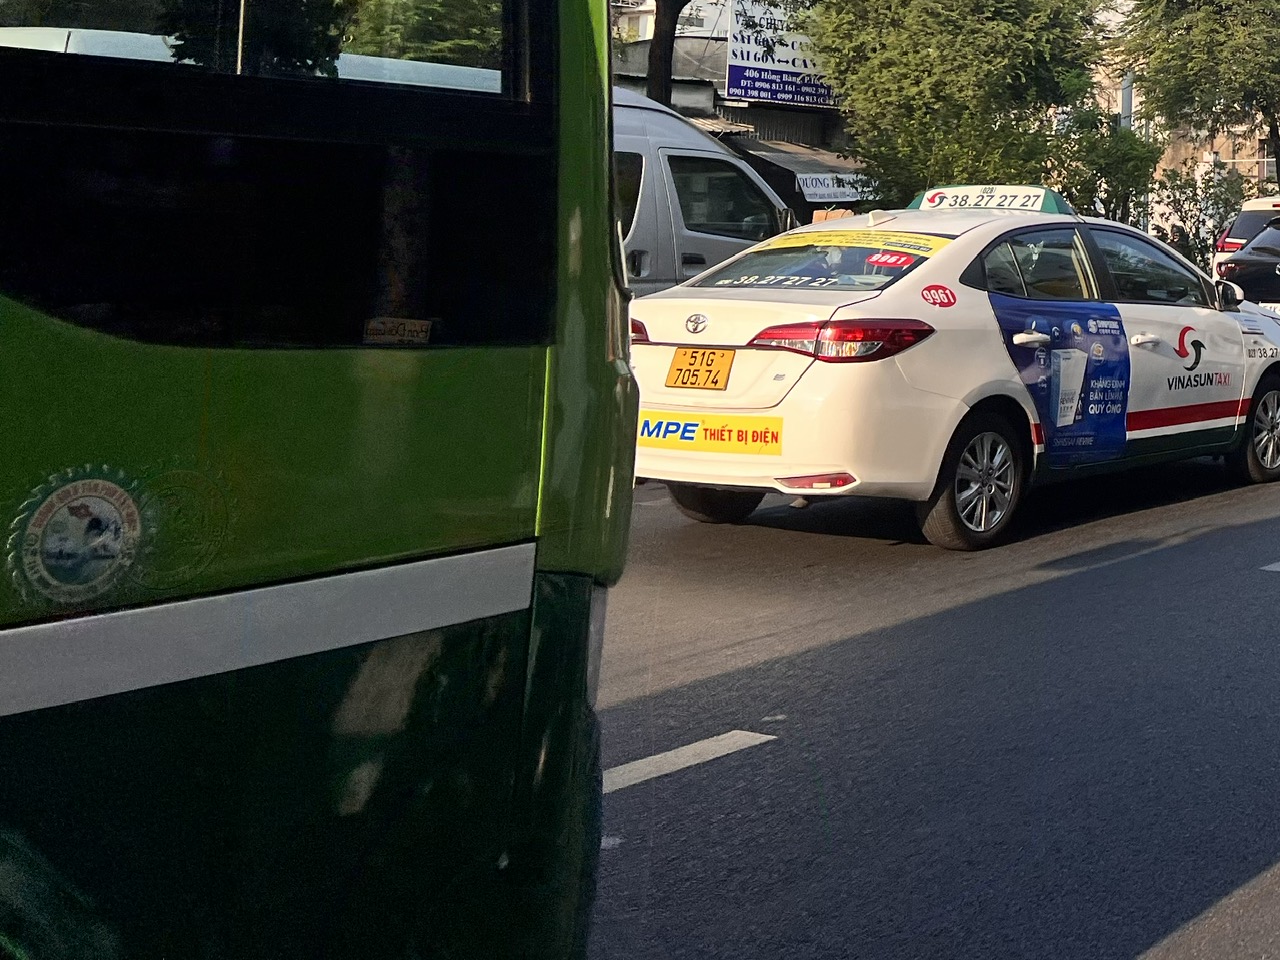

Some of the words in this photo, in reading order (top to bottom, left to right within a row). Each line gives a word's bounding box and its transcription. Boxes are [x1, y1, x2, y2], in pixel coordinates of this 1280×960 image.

[732, 47, 750, 62] SÀI
[744, 69, 759, 78] 406
[761, 70, 781, 82] Hồng
[755, 80, 770, 89] 0906
[771, 82, 783, 90] 813
[785, 83, 796, 92] 161
[729, 87, 745, 96] 0901
[747, 89, 759, 98] 398
[760, 90, 772, 99] 001
[777, 92, 792, 100] 0909
[949, 195, 994, 207] 38.27
[995, 195, 1018, 207] 27
[1020, 195, 1041, 207] 27
[869, 253, 908, 264] 9961
[733, 276, 783, 285] 38.27
[784, 276, 806, 286] 27
[809, 278, 838, 287] 27
[923, 290, 954, 304] 9961
[689, 351, 716, 366] 51G
[674, 369, 721, 386] 705.74
[1089, 401, 1105, 414] QUÝ
[1106, 401, 1121, 414] ÔNG
[640, 420, 699, 441] MPE
[703, 424, 733, 441] THIẾT
[737, 430, 748, 445] BỊ
[752, 427, 779, 446] ĐIỆN
